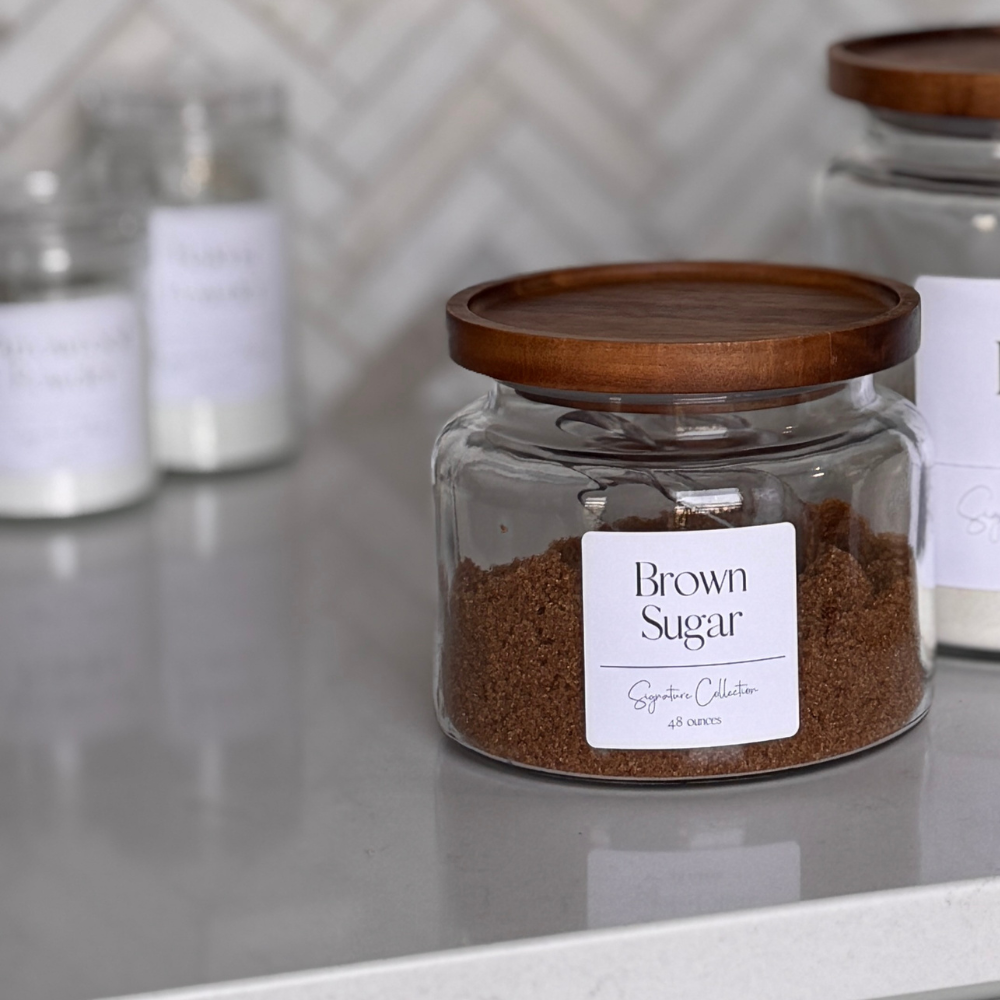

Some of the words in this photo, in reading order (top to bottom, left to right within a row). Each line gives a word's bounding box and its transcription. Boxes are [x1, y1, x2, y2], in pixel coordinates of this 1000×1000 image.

[635, 561, 747, 597] Brown
[641, 604, 743, 651] Sugar
[627, 679, 692, 714] Signature
[694, 677, 759, 707] Collection
[667, 716, 683, 730] 48
[686, 716, 722, 727] ounces
